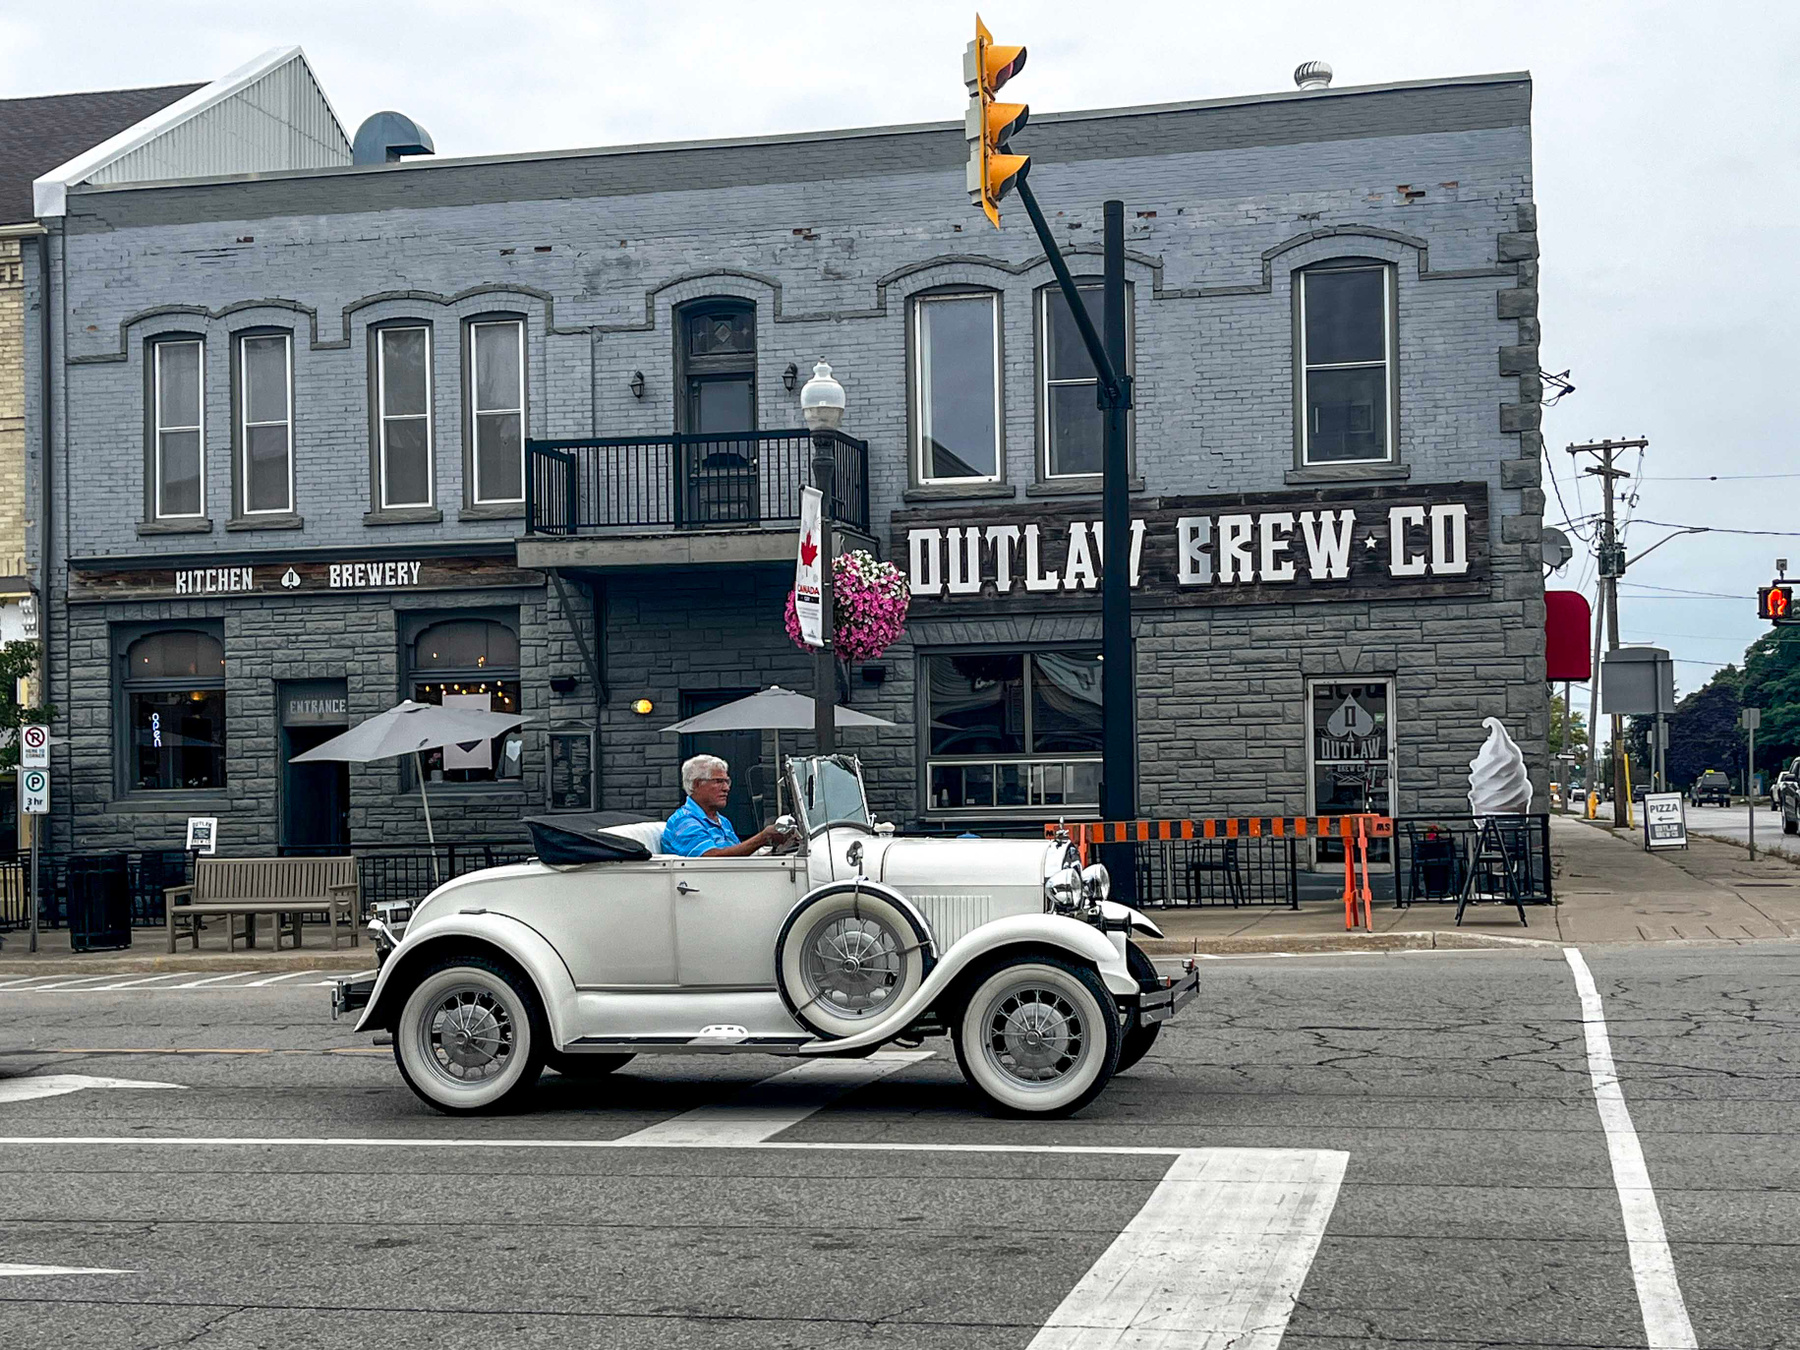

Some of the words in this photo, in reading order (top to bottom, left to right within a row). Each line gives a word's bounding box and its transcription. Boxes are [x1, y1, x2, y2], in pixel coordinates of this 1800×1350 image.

[1176, 509, 1357, 585] BREW
[1388, 503, 1470, 576] CO
[175, 567, 254, 594] KITCHEN
[329, 561, 421, 588] BREWERY
[797, 583, 820, 596] CANADA
[290, 699, 346, 714] ENTRANCE
[1321, 736, 1381, 760] OUTLAW
[31, 777, 40, 788] P
[27, 798, 32, 806] 3
[34, 797, 43, 805] hr
[1650, 803, 1678, 813] PIZZA
